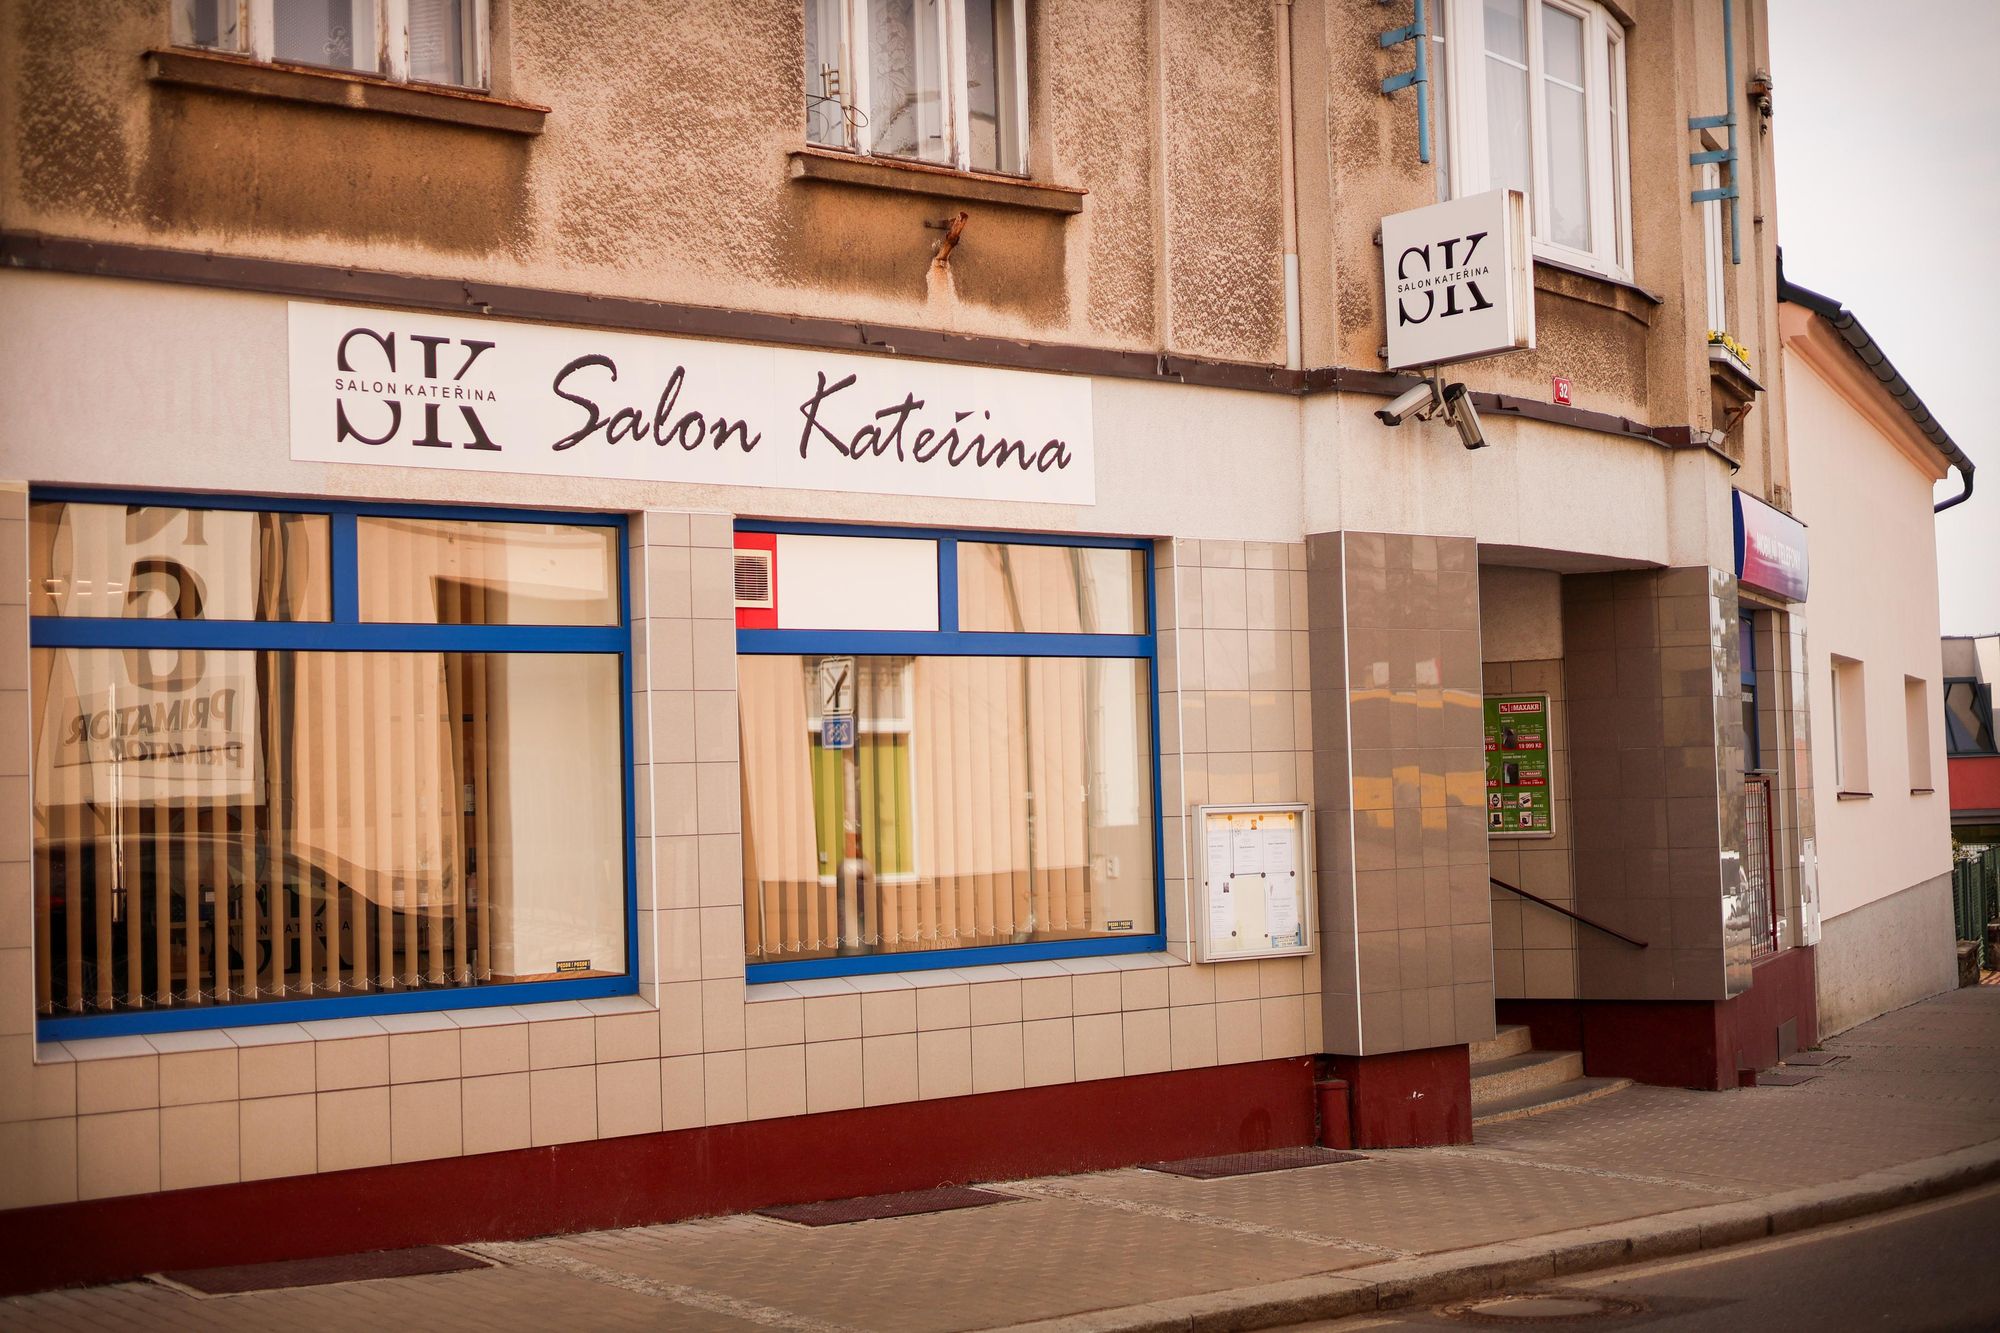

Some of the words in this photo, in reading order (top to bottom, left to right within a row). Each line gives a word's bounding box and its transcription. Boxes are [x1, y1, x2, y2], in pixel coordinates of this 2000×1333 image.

[1397, 278, 1431, 293] SALON
[1434, 265, 1489, 285] KATEŘINA
[1398, 231, 1493, 327] SK
[335, 378, 397, 395] SALON
[404, 383, 497, 402] KATEŘINA
[337, 327, 502, 452] SK
[552, 354, 761, 452] Salon
[799, 371, 1072, 473] Kateřina
[1559, 382, 1568, 398] 32
